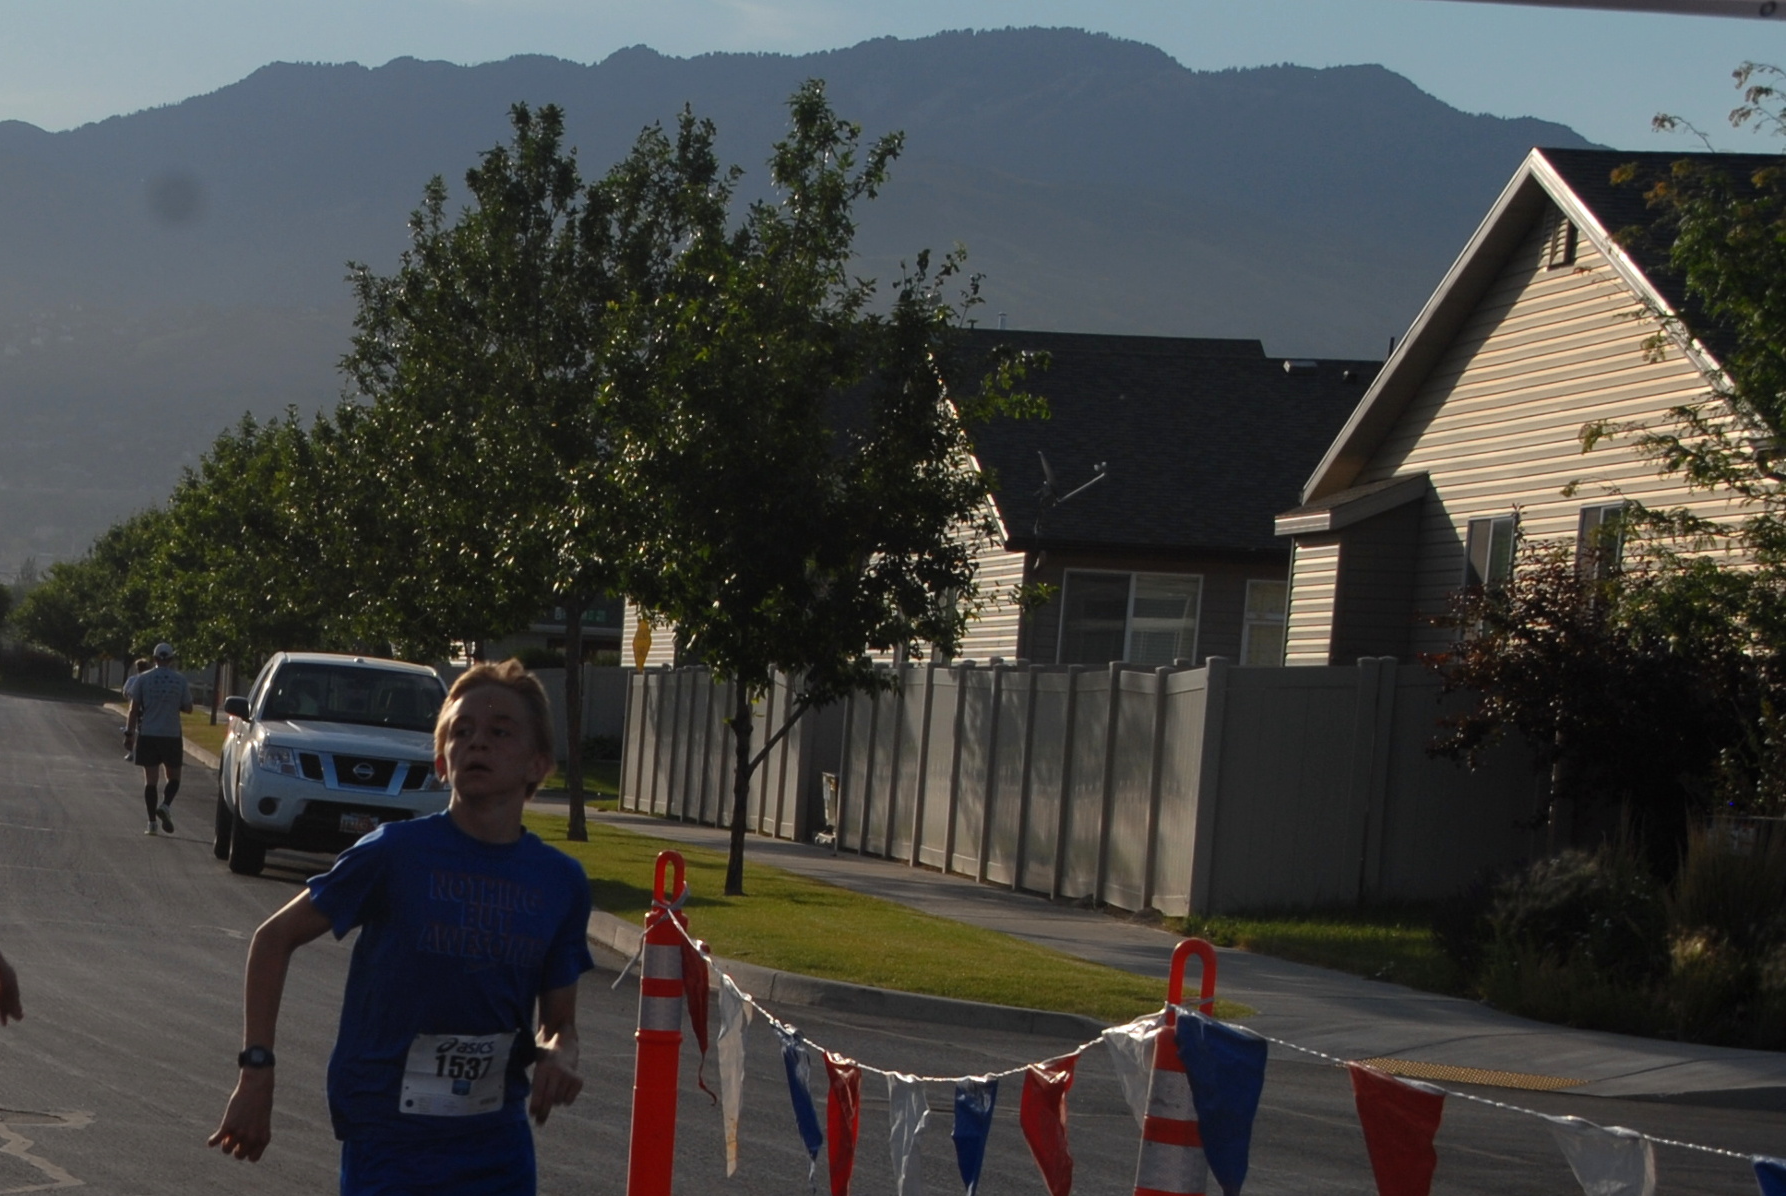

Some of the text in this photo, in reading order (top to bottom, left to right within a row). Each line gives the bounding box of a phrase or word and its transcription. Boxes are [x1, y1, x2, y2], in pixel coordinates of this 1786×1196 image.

[429, 871, 543, 915] NOTHING
[460, 901, 512, 936] BUT
[416, 921, 545, 968] AWESOME
[457, 1041, 494, 1054] asics
[435, 1054, 494, 1080] 1537
